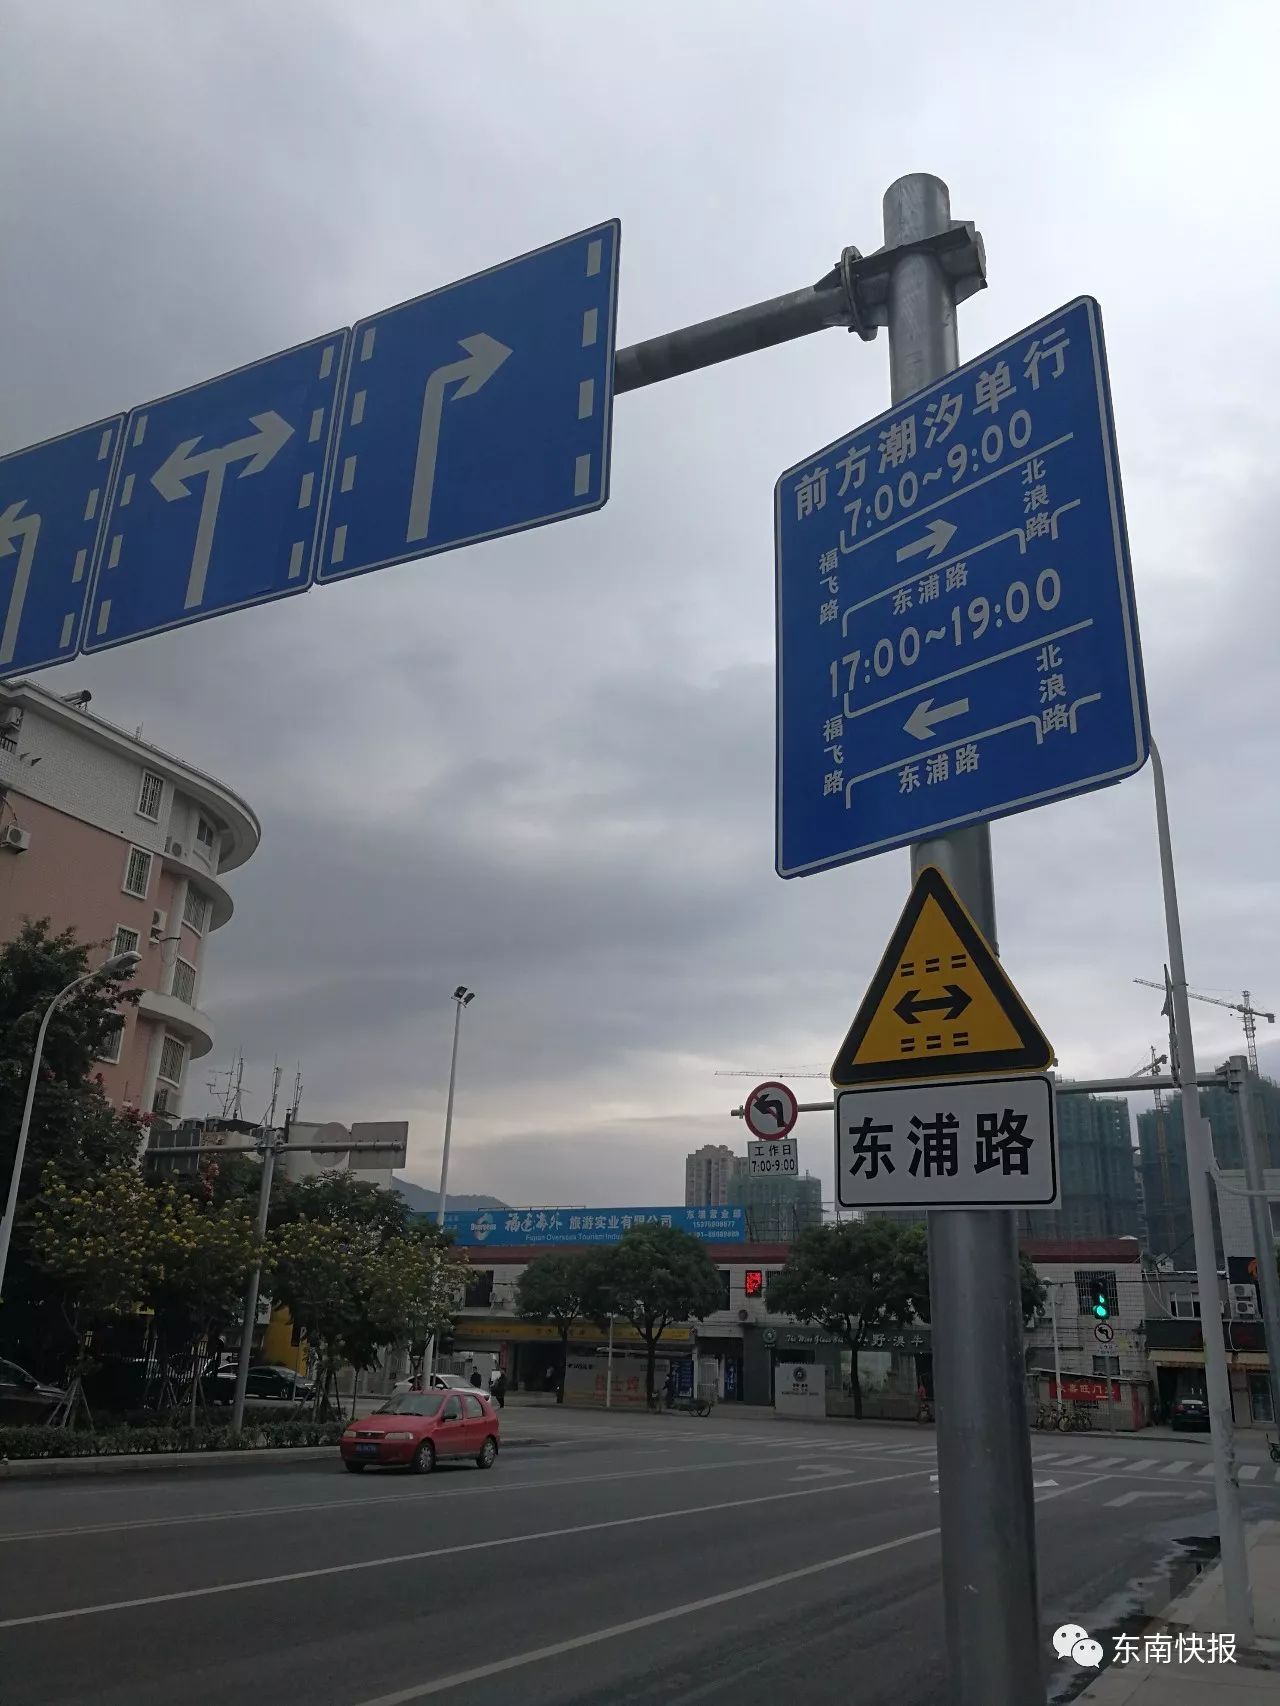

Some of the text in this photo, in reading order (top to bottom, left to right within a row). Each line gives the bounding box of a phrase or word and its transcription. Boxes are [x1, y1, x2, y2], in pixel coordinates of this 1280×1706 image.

[794, 327, 1070, 521] 前方潮汐单行
[843, 408, 1033, 538] 7:00~9:00
[1021, 458, 1051, 543] 北浪路
[818, 547, 840, 626] 福飞路
[892, 562, 969, 616] 东浦路
[828, 567, 1062, 698] 17:00~19:00
[1036, 643, 1069, 735] 北浪路
[822, 714, 844, 797] 福飞路
[898, 743, 980, 794] 东浦路
[751, 1158, 795, 1173] 7:00-9:00
[754, 1144, 791, 1156] 工作日
[848, 1108, 1035, 1180] 东浦路
